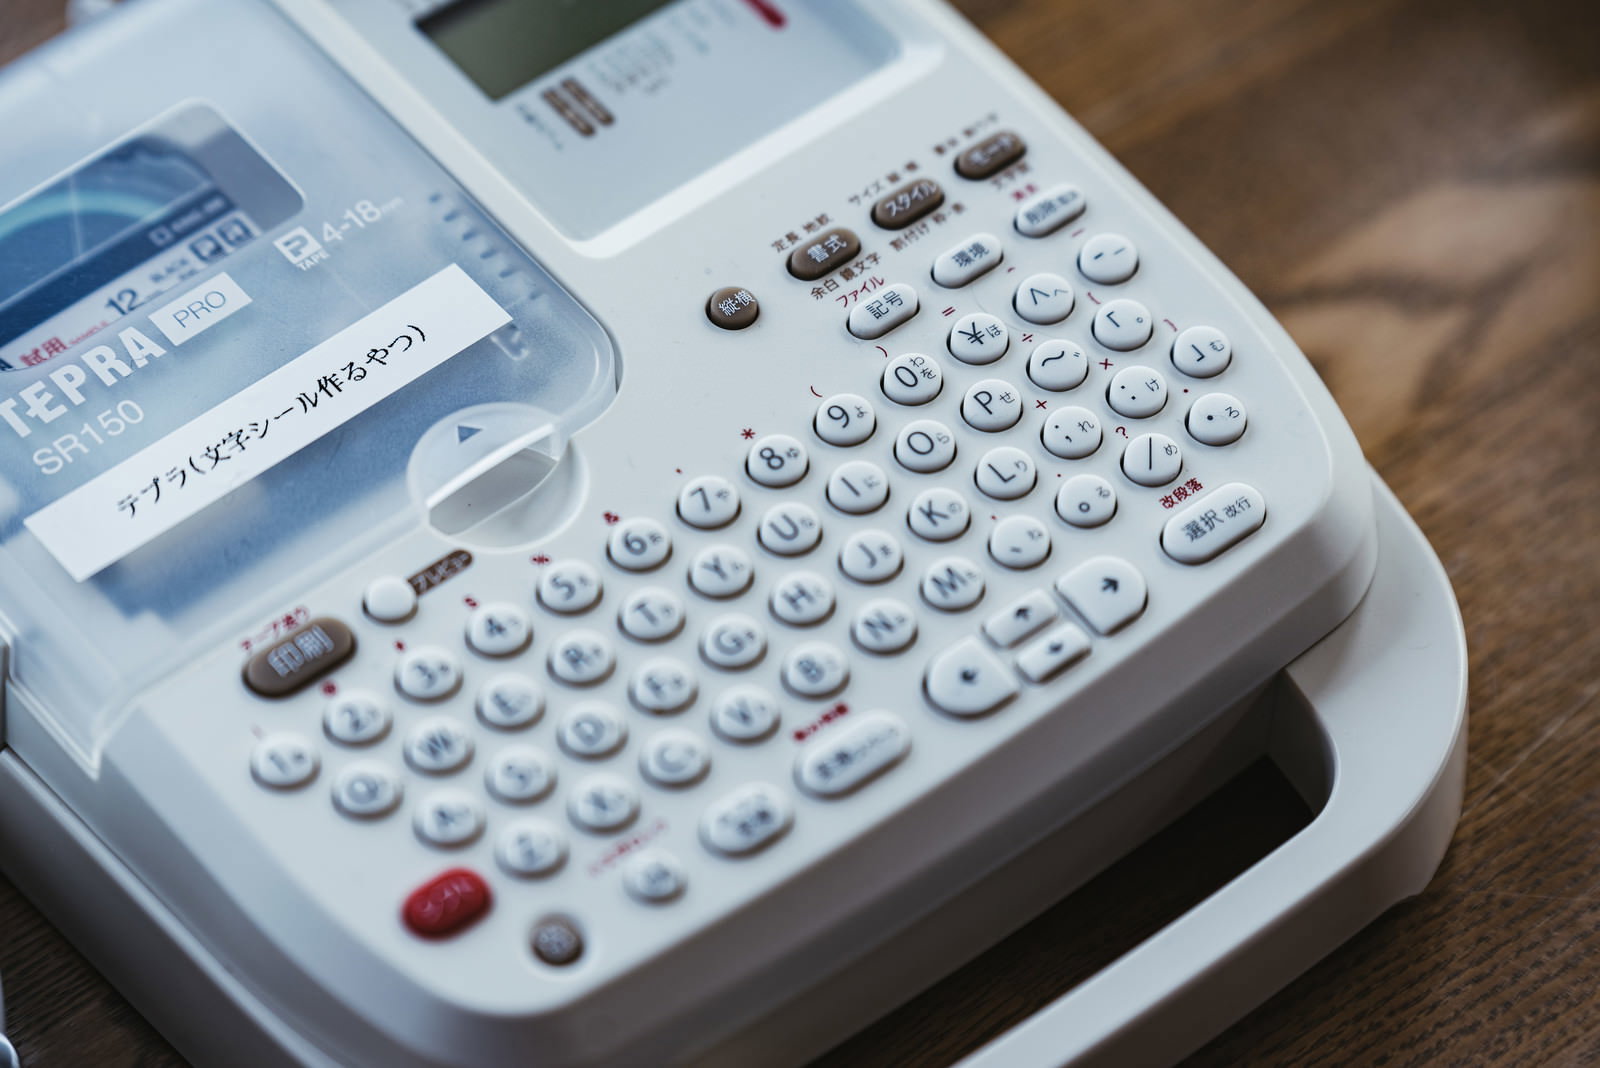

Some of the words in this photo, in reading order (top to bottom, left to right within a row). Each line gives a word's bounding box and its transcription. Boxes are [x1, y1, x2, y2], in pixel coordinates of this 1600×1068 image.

[886, 183, 937, 217] スタイル
[296, 250, 331, 272] TAPE
[807, 234, 847, 263] 書式
[952, 242, 989, 268] 環境
[105, 287, 143, 317] 12
[810, 278, 839, 301] 余白
[835, 276, 885, 308] ファイル
[171, 291, 227, 329] PRO
[865, 290, 904, 320] 記号
[19, 337, 68, 366] 試用
[0, 325, 168, 439] TEPRA
[826, 404, 851, 430] 9
[972, 390, 995, 416] P
[33, 399, 145, 475] SR150
[759, 446, 786, 471] 8
[987, 462, 1018, 485] L
[689, 486, 713, 513] 7
[1158, 478, 1204, 509] 改段落
[768, 511, 801, 542] U
[917, 499, 950, 528] K
[1181, 509, 1224, 542] 選択
[1223, 496, 1252, 518] 改行
[623, 531, 648, 556] 6
[700, 554, 729, 582] Y
[930, 566, 969, 599] M
[551, 572, 577, 602] 5
[781, 582, 817, 613] H
[484, 616, 509, 640] 4
[633, 601, 659, 627] T
